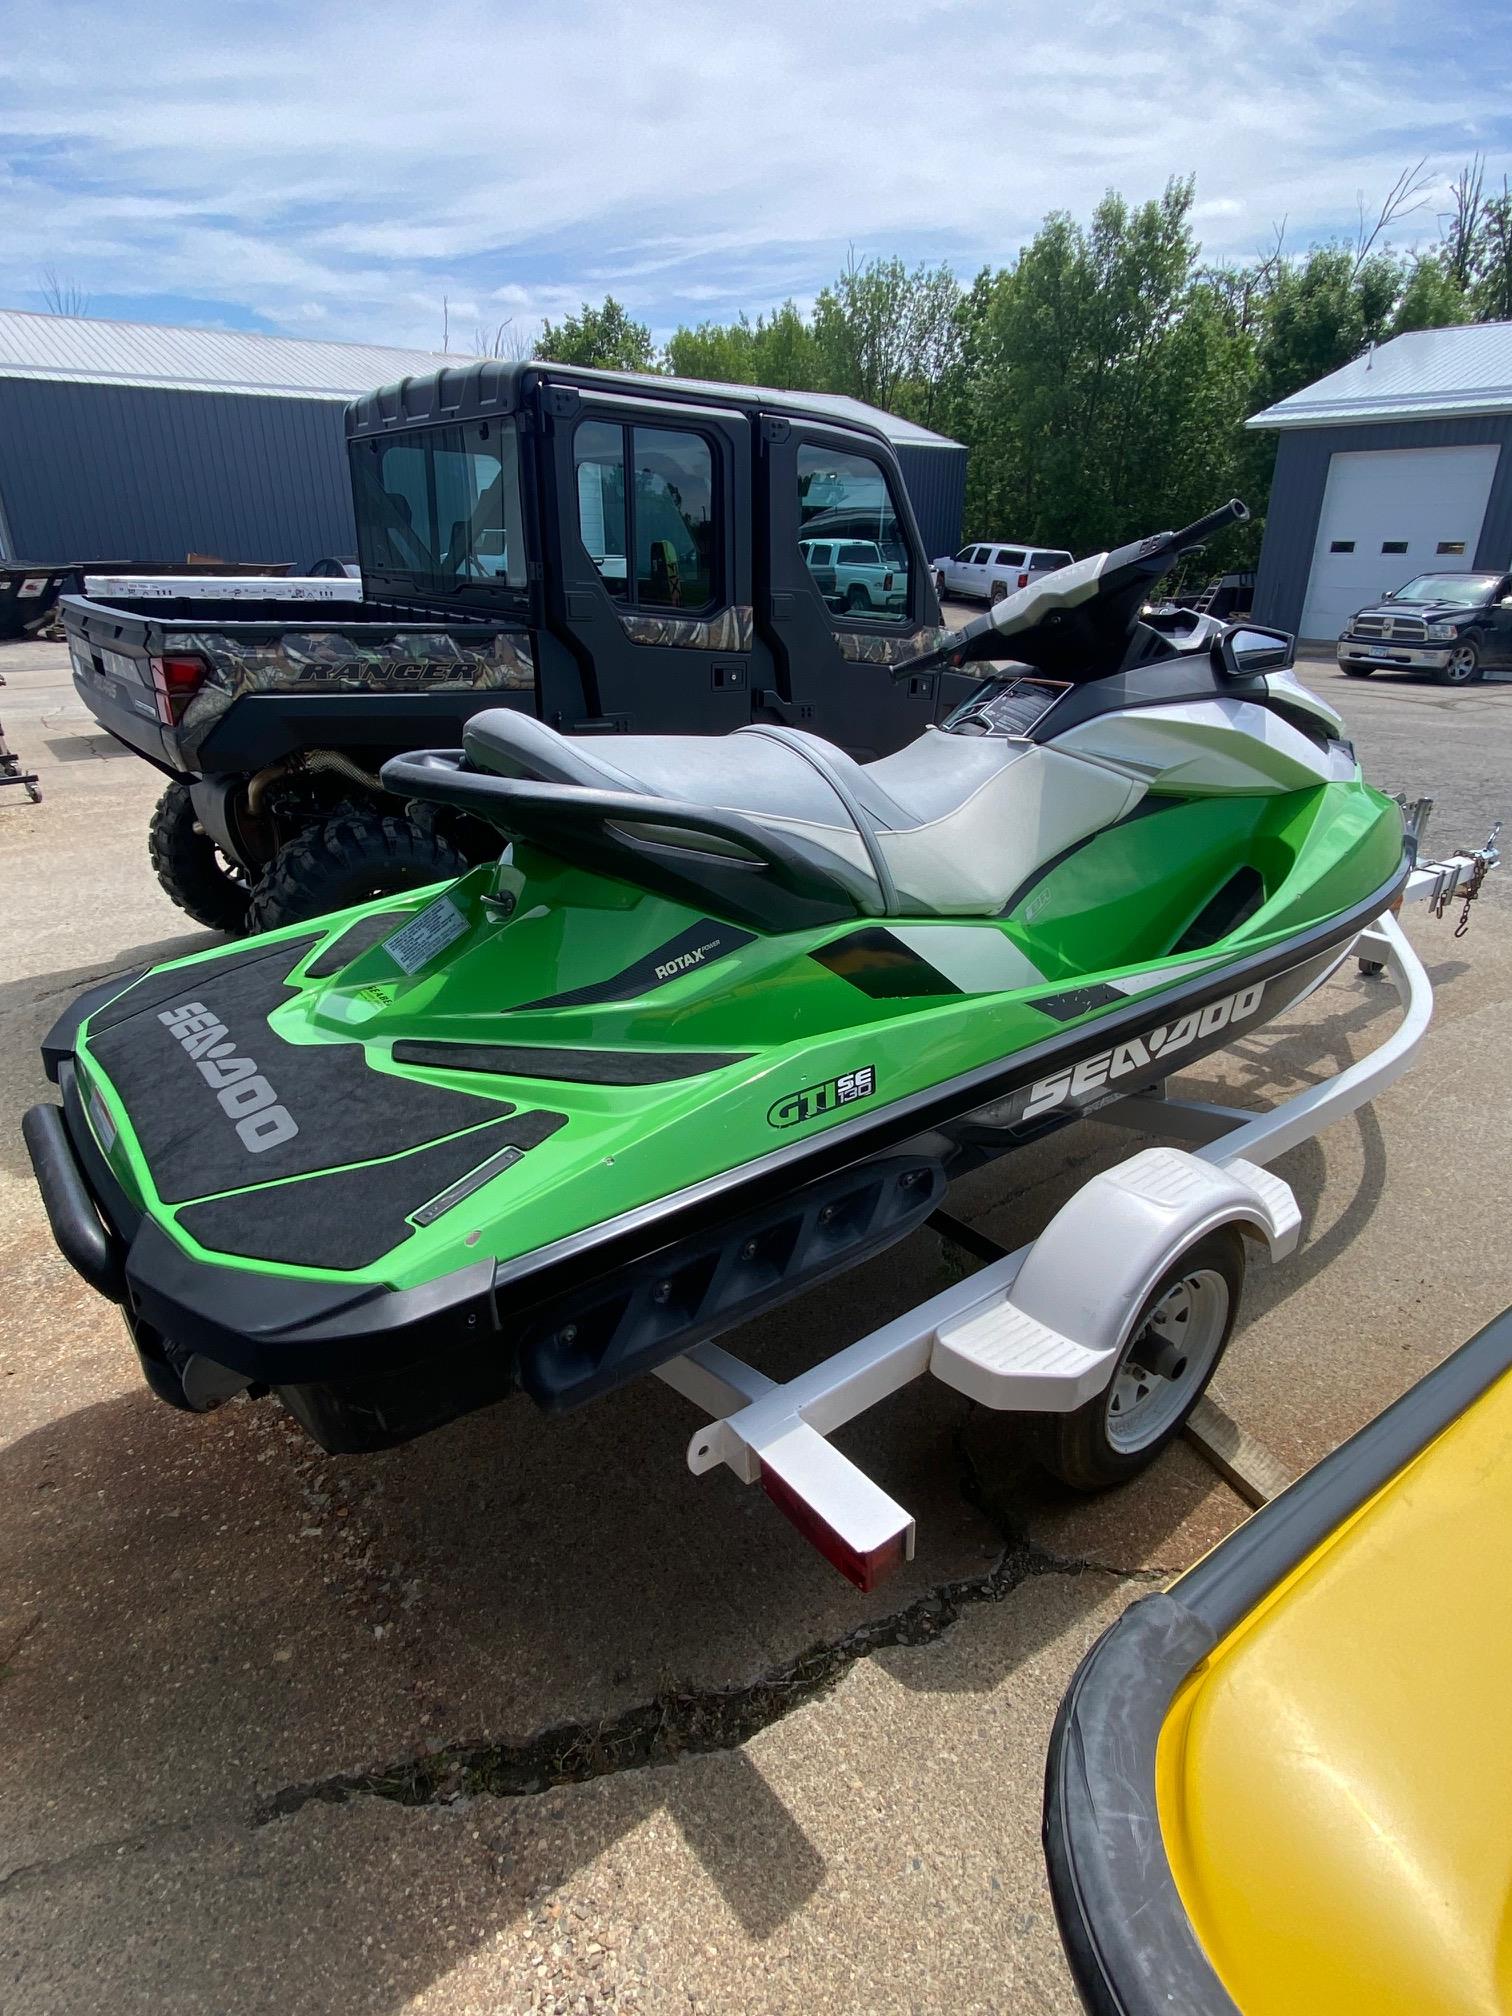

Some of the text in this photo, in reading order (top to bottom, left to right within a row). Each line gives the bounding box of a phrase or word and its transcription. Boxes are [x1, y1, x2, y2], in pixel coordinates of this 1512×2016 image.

[297, 662, 479, 681] RANGER
[655, 939, 720, 979] ROTAX POWER
[767, 1068, 872, 1128] GTI SE
[838, 1082, 872, 1104] 130
